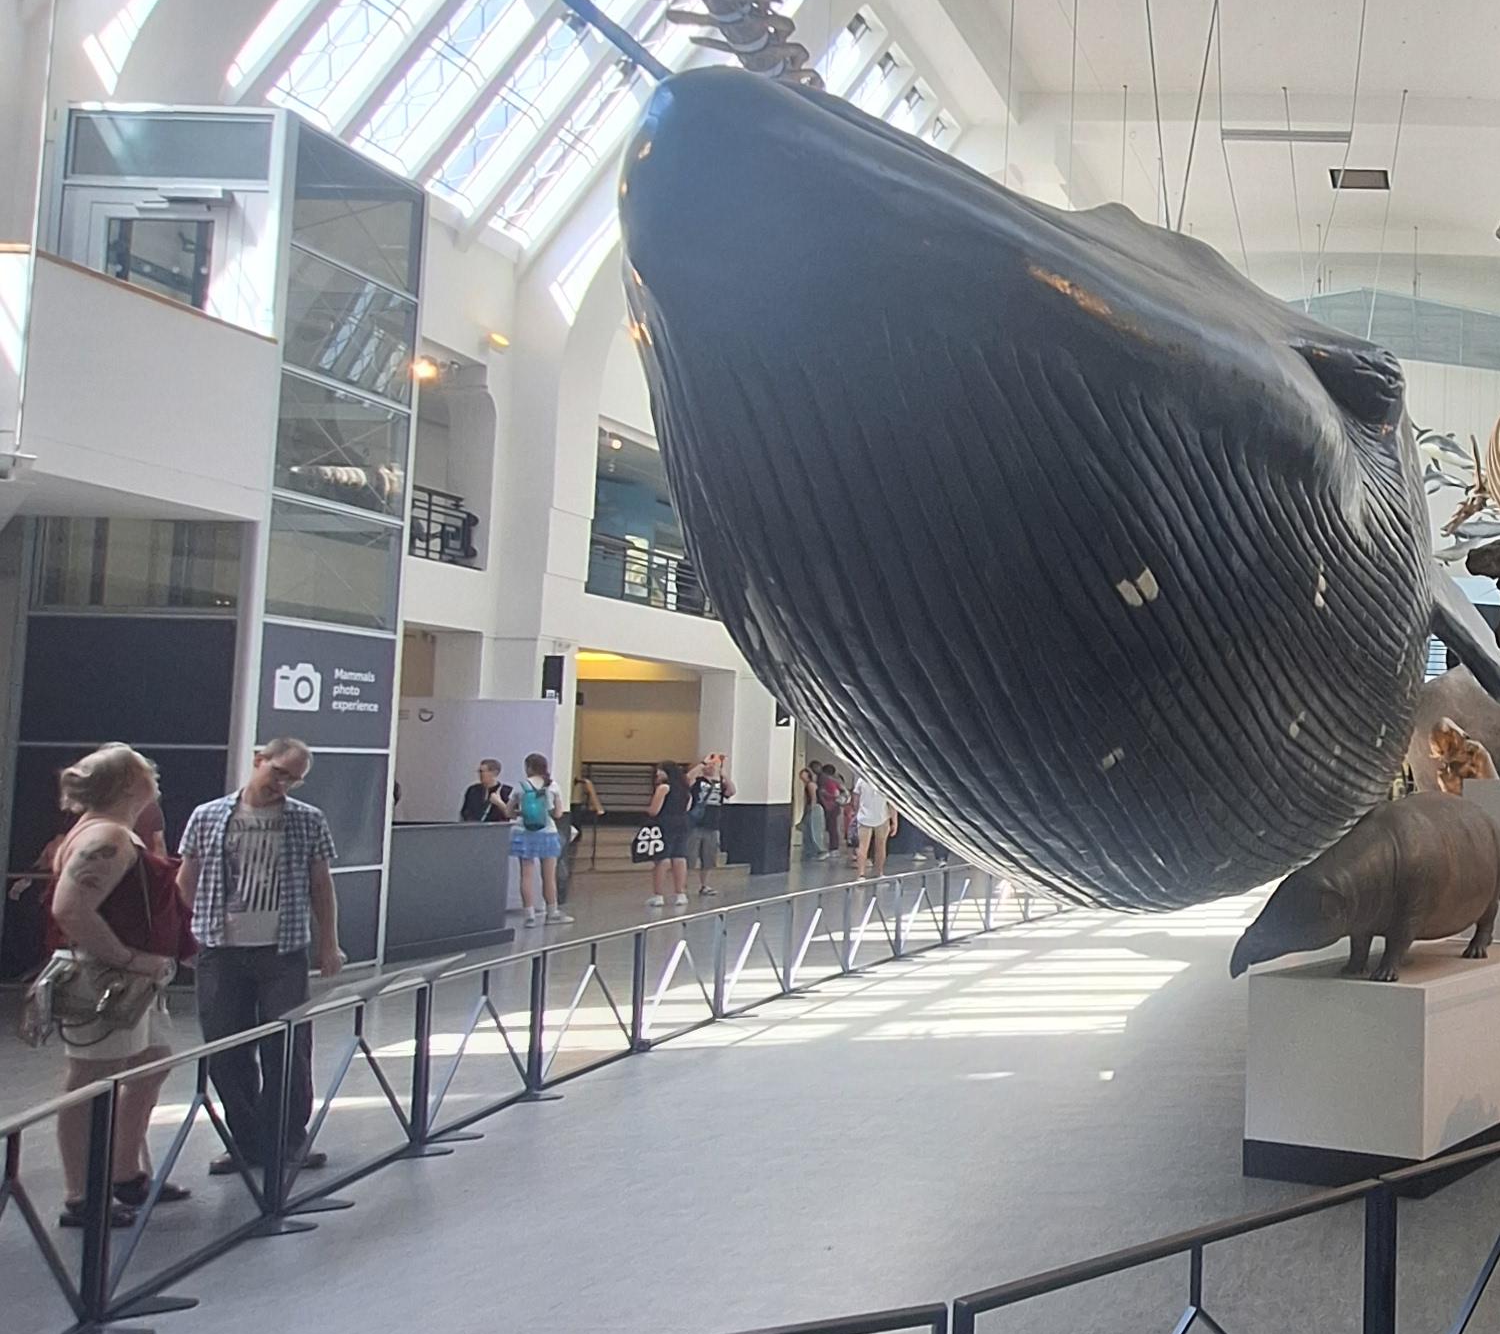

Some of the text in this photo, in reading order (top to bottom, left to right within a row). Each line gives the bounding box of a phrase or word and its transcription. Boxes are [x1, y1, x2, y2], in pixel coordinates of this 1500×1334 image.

[334, 668, 375, 683] Mammals
[333, 684, 360, 697] photo
[332, 699, 379, 713] experience
